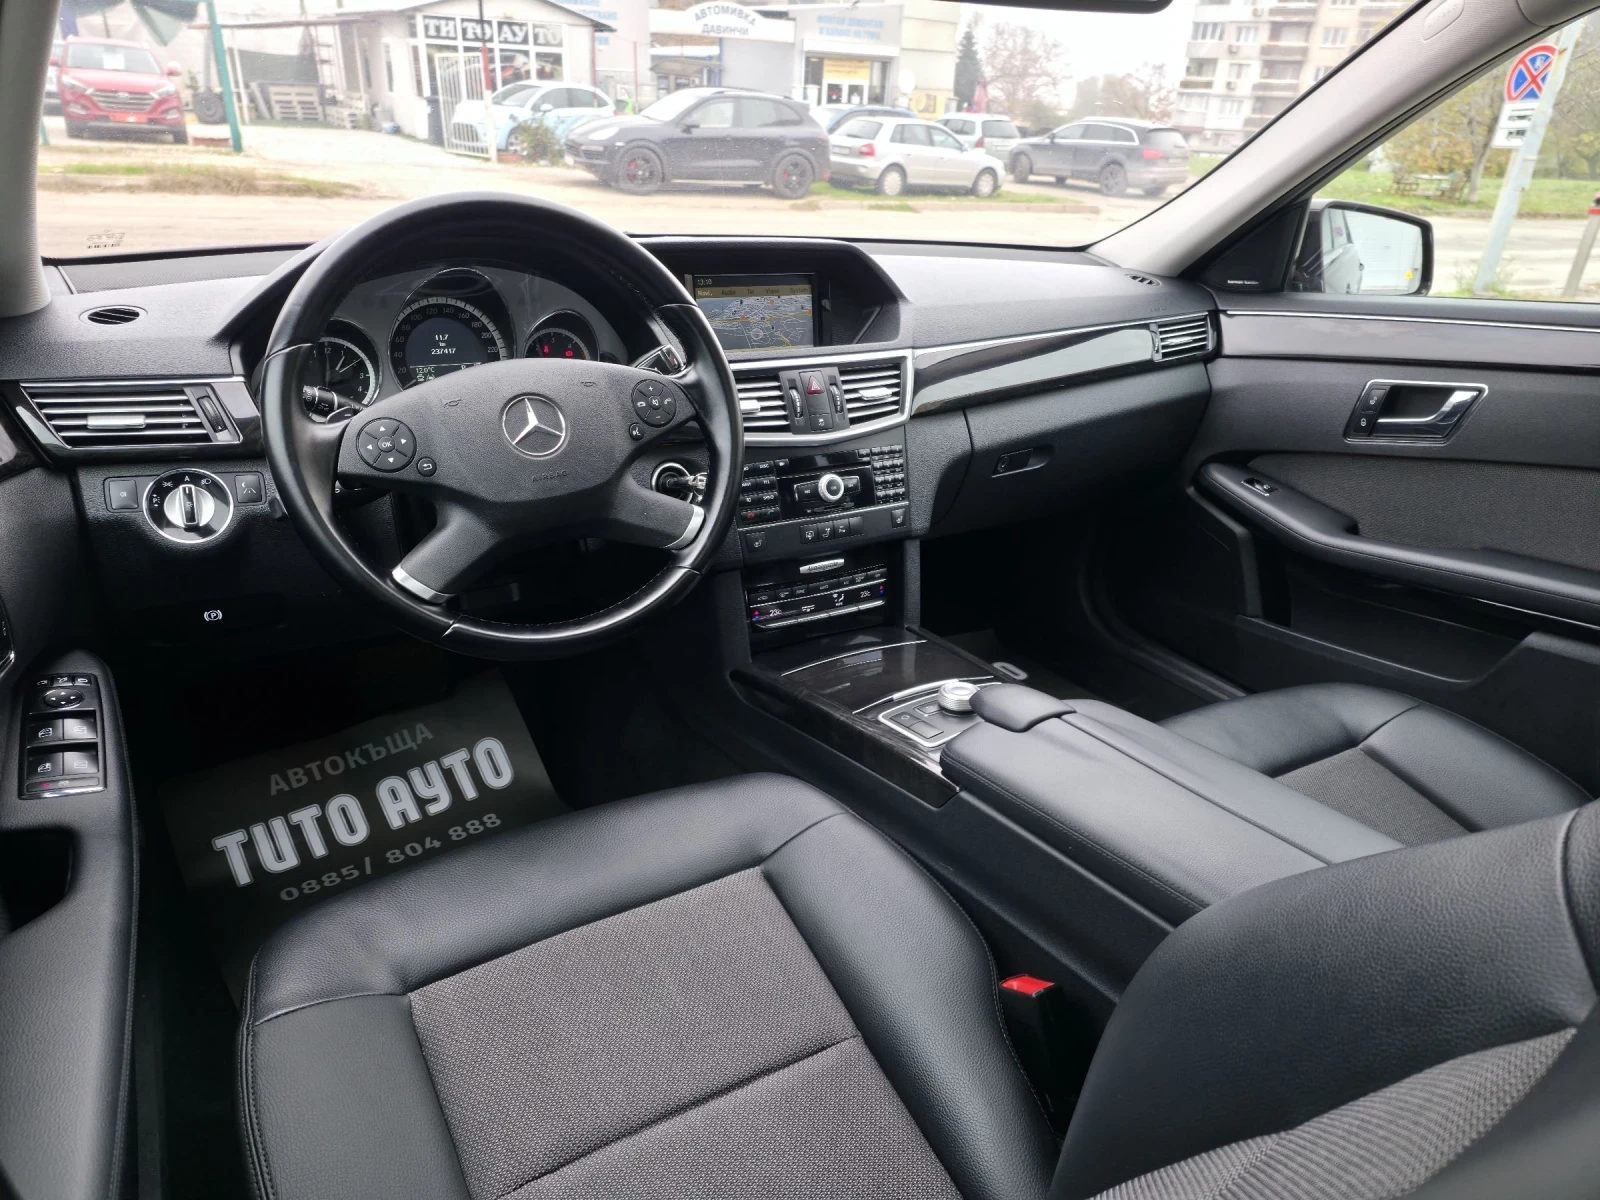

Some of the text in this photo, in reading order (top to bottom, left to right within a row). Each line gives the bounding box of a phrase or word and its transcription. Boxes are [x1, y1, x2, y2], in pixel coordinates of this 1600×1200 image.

[694, 5, 756, 26] АВТОМИВКА
[701, 24, 749, 36] ДАВИНЧИ
[426, 307, 438, 315] 120
[442, 306, 454, 314] 140
[410, 313, 422, 321] 100
[381, 440, 393, 449] OK
[269, 722, 435, 796] АВТОКЪЩА
[384, 835, 443, 865] 804
[447, 813, 503, 842] 888
